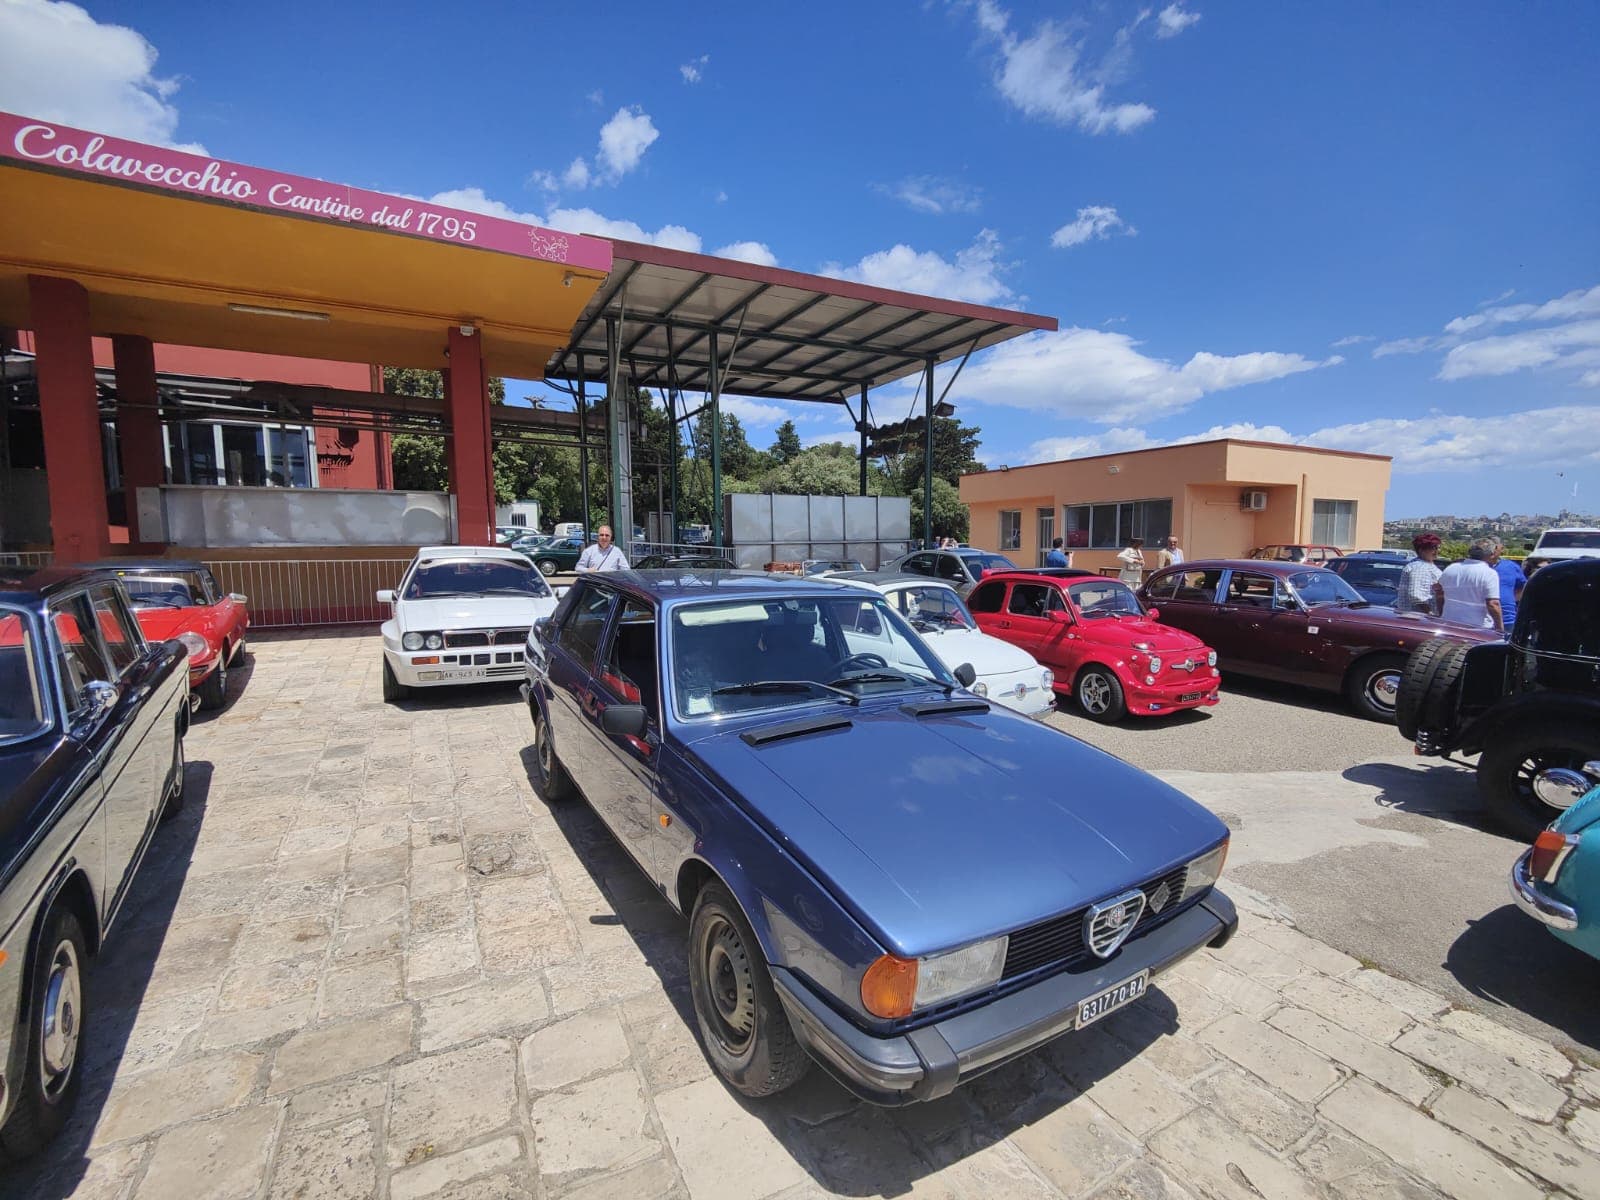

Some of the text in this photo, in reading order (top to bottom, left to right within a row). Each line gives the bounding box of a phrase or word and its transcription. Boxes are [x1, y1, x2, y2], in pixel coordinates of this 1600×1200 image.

[14, 124, 477, 241] Colavecchio Cantine dal 1795
[1082, 976, 1143, 1021] 631770 BA
